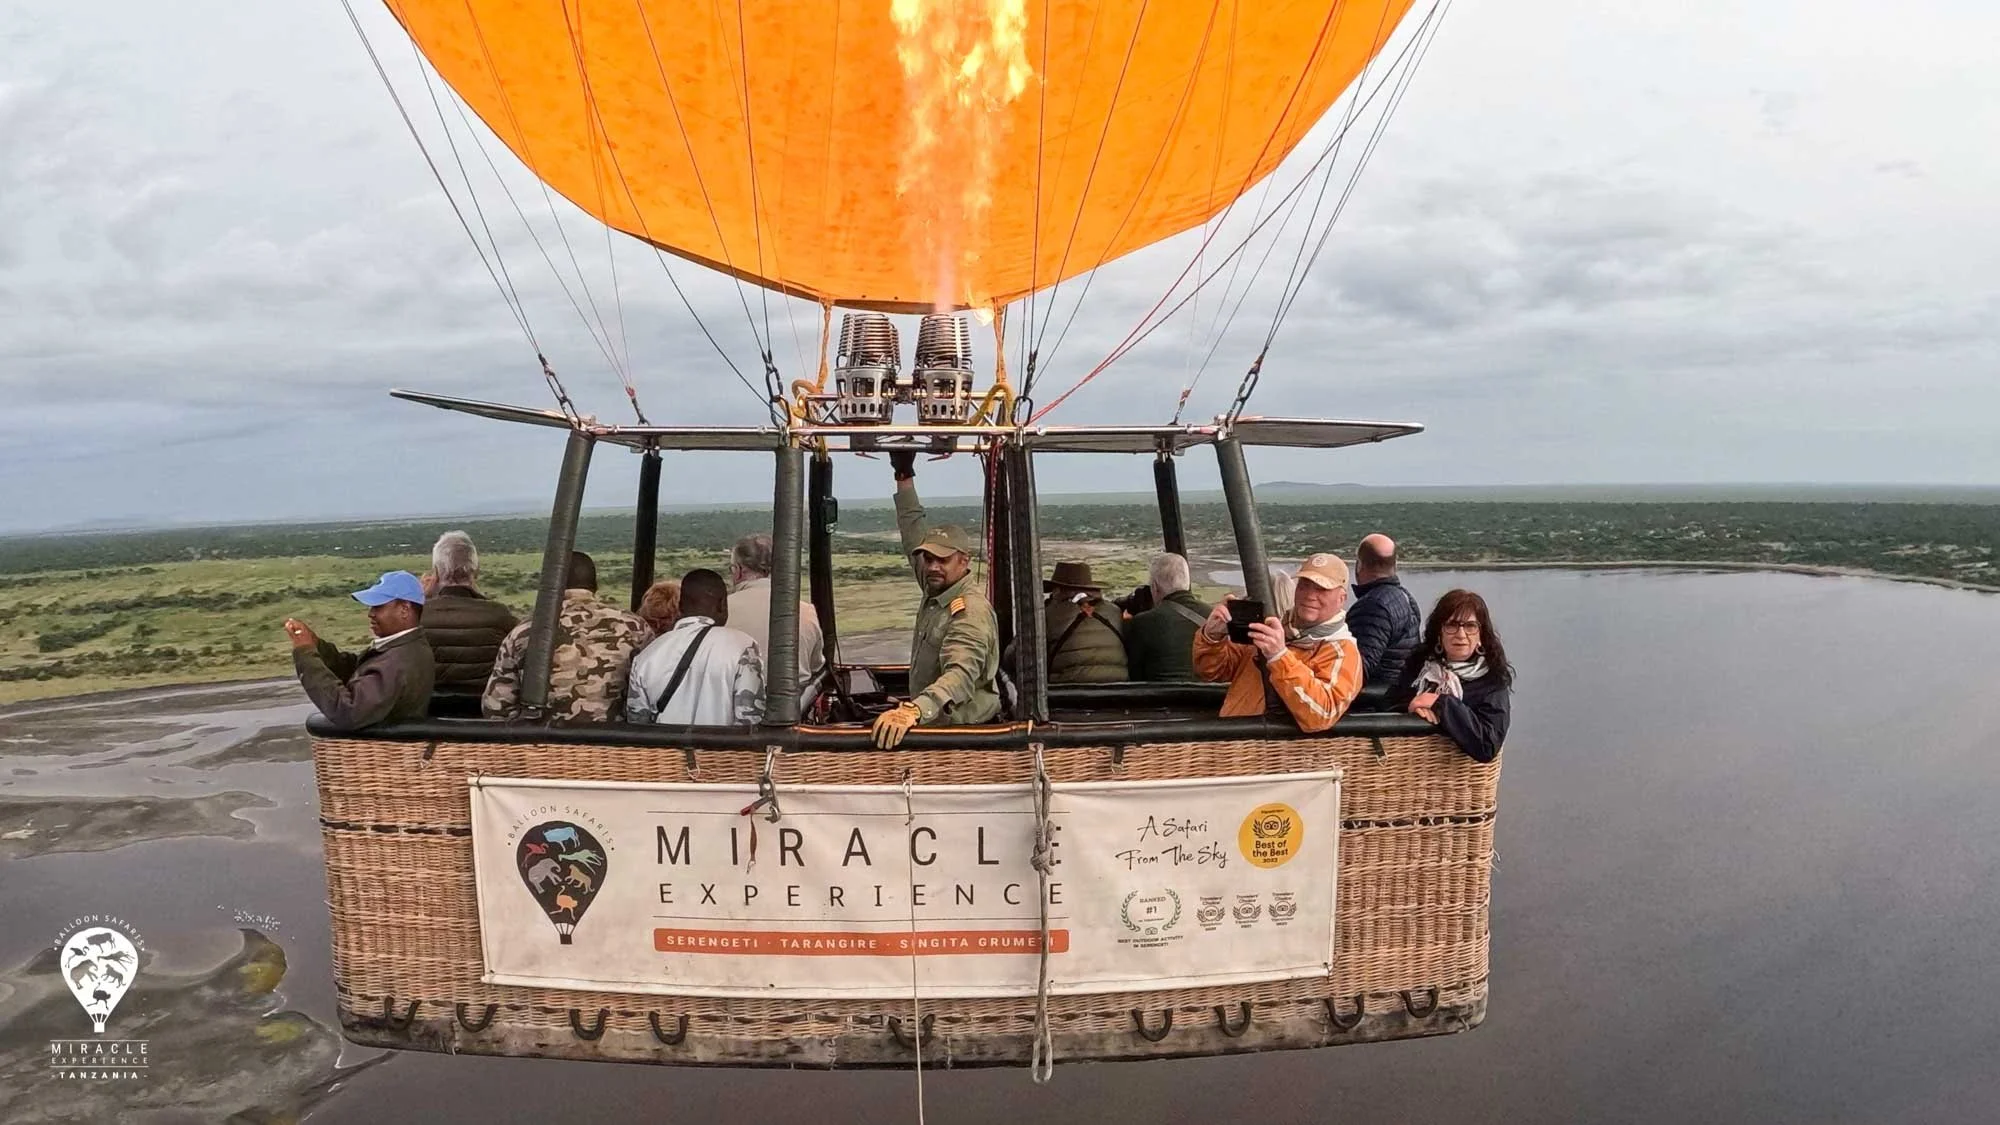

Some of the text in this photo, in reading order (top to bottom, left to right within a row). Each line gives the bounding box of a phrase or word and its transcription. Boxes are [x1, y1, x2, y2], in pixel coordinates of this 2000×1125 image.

[508, 805, 614, 844] BALLOON SAFARIS
[1137, 815, 1208, 842] A Safari
[656, 825, 1062, 866] MIRACL
[1115, 841, 1230, 870] From The Sky
[1252, 848, 1288, 857] the Best
[1255, 840, 1287, 849] Best of
[659, 883, 1063, 907] EXPERIENCE
[1146, 905, 1157, 914] #1
[666, 935, 758, 948] SERENGETI
[780, 938, 878, 949] TARANGIRE
[978, 936, 1054, 947] GRUMEI
